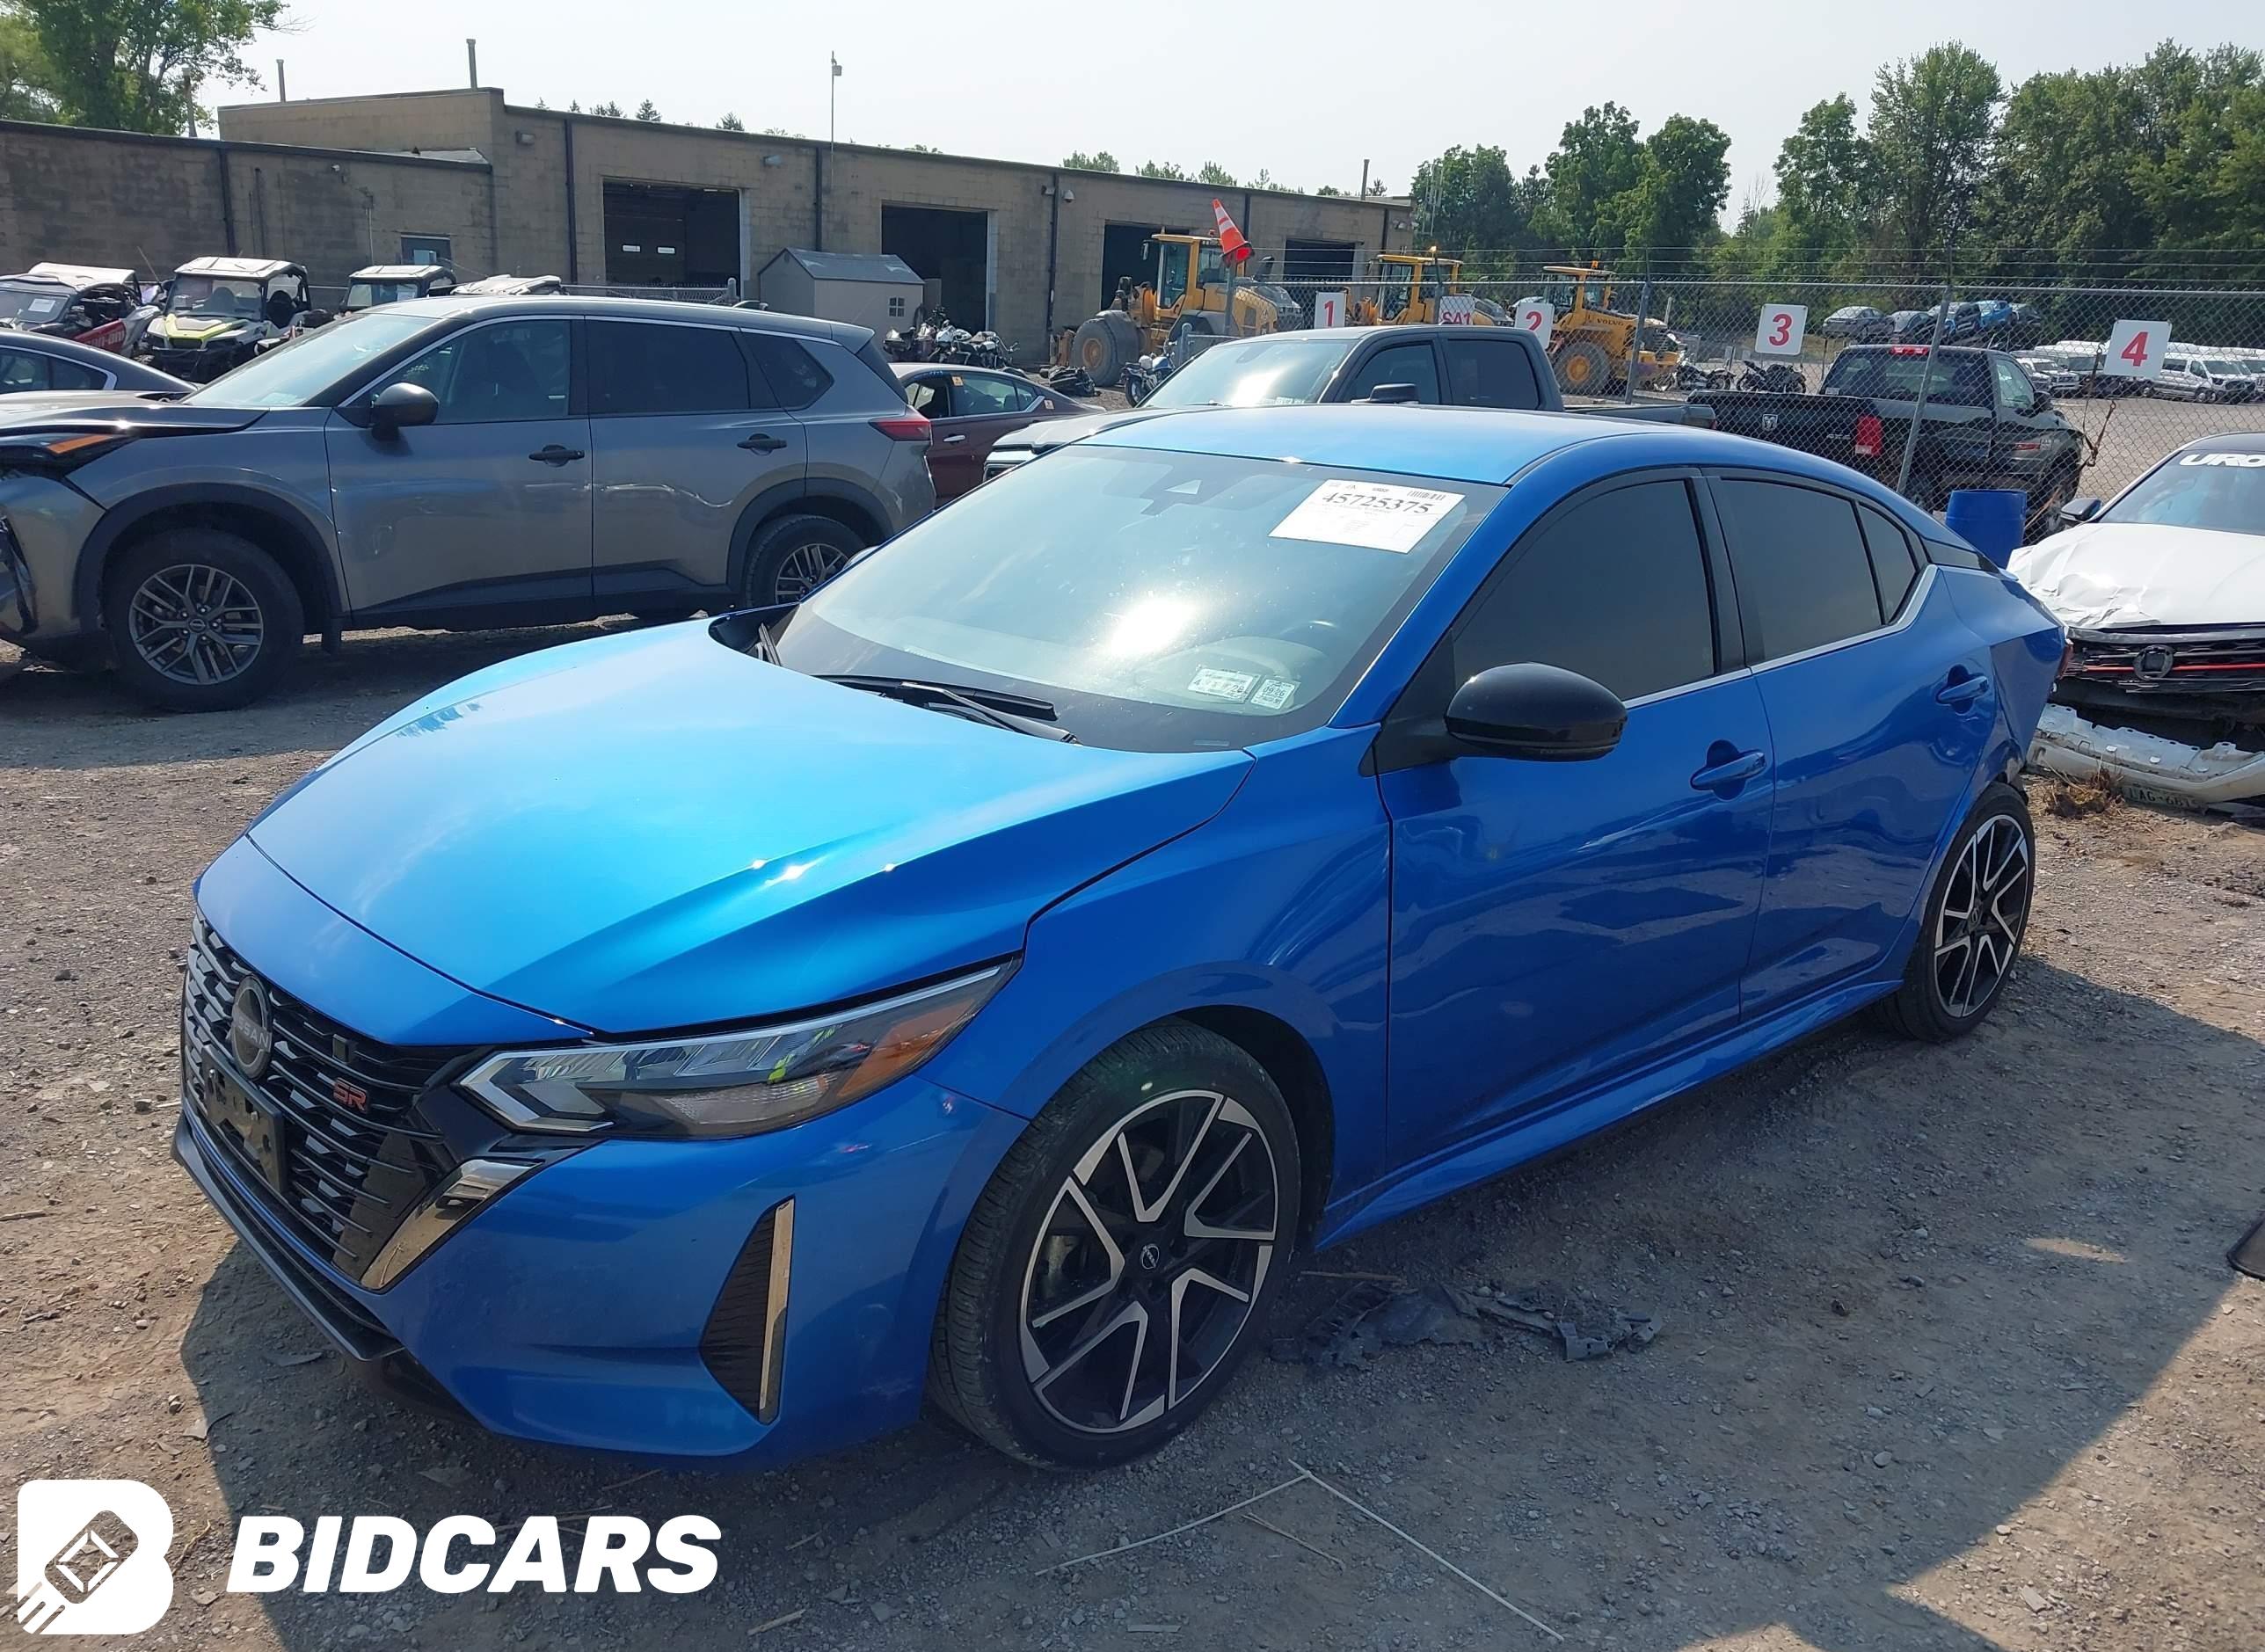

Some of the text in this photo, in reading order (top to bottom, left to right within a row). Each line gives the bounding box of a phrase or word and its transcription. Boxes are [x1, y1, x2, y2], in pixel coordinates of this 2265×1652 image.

[1324, 301, 1335, 327] 1
[1526, 310, 1542, 331] 2
[1769, 313, 1792, 346] 3
[2121, 331, 2149, 367] 4
[1322, 492, 1435, 514] 45725375
[233, 1010, 269, 1048] SSAN
[333, 1078, 368, 1111] SR
